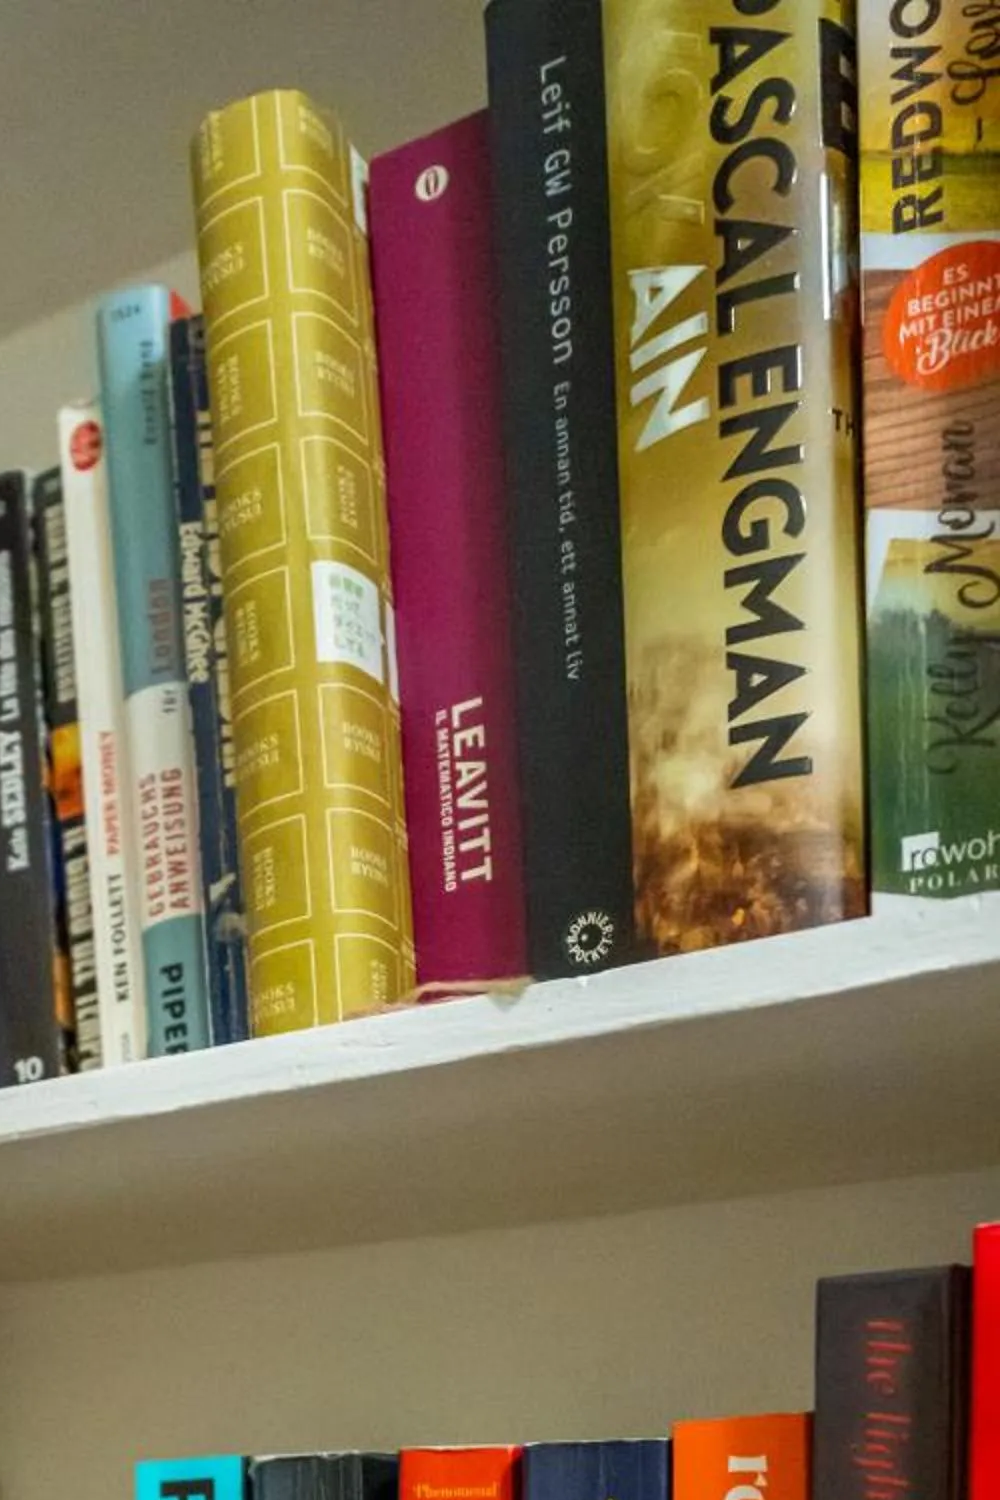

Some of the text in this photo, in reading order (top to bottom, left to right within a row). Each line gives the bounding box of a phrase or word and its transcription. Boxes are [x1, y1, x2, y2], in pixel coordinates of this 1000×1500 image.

[540, 54, 576, 366] Leif GW Persson
[942, 263, 969, 284] ES
[899, 312, 937, 344] MIT
[916, 323, 1000, 376] Blick
[553, 379, 571, 410] En
[554, 415, 573, 486] annan
[930, 418, 1000, 610] Moran
[560, 538, 577, 574] ett
[718, 344, 814, 789] ENGMAN
[562, 578, 582, 645] annat
[567, 648, 583, 681] liv
[448, 695, 493, 884] LEAVITT
[102, 799, 122, 858] PAPER
[138, 771, 166, 918] GEBRAUCHS
[160, 766, 192, 910] ANWEISUNG
[106, 871, 131, 1002] KEN FOLLETT
[15, 1056, 45, 1083] 10
[865, 1319, 913, 1396] the
